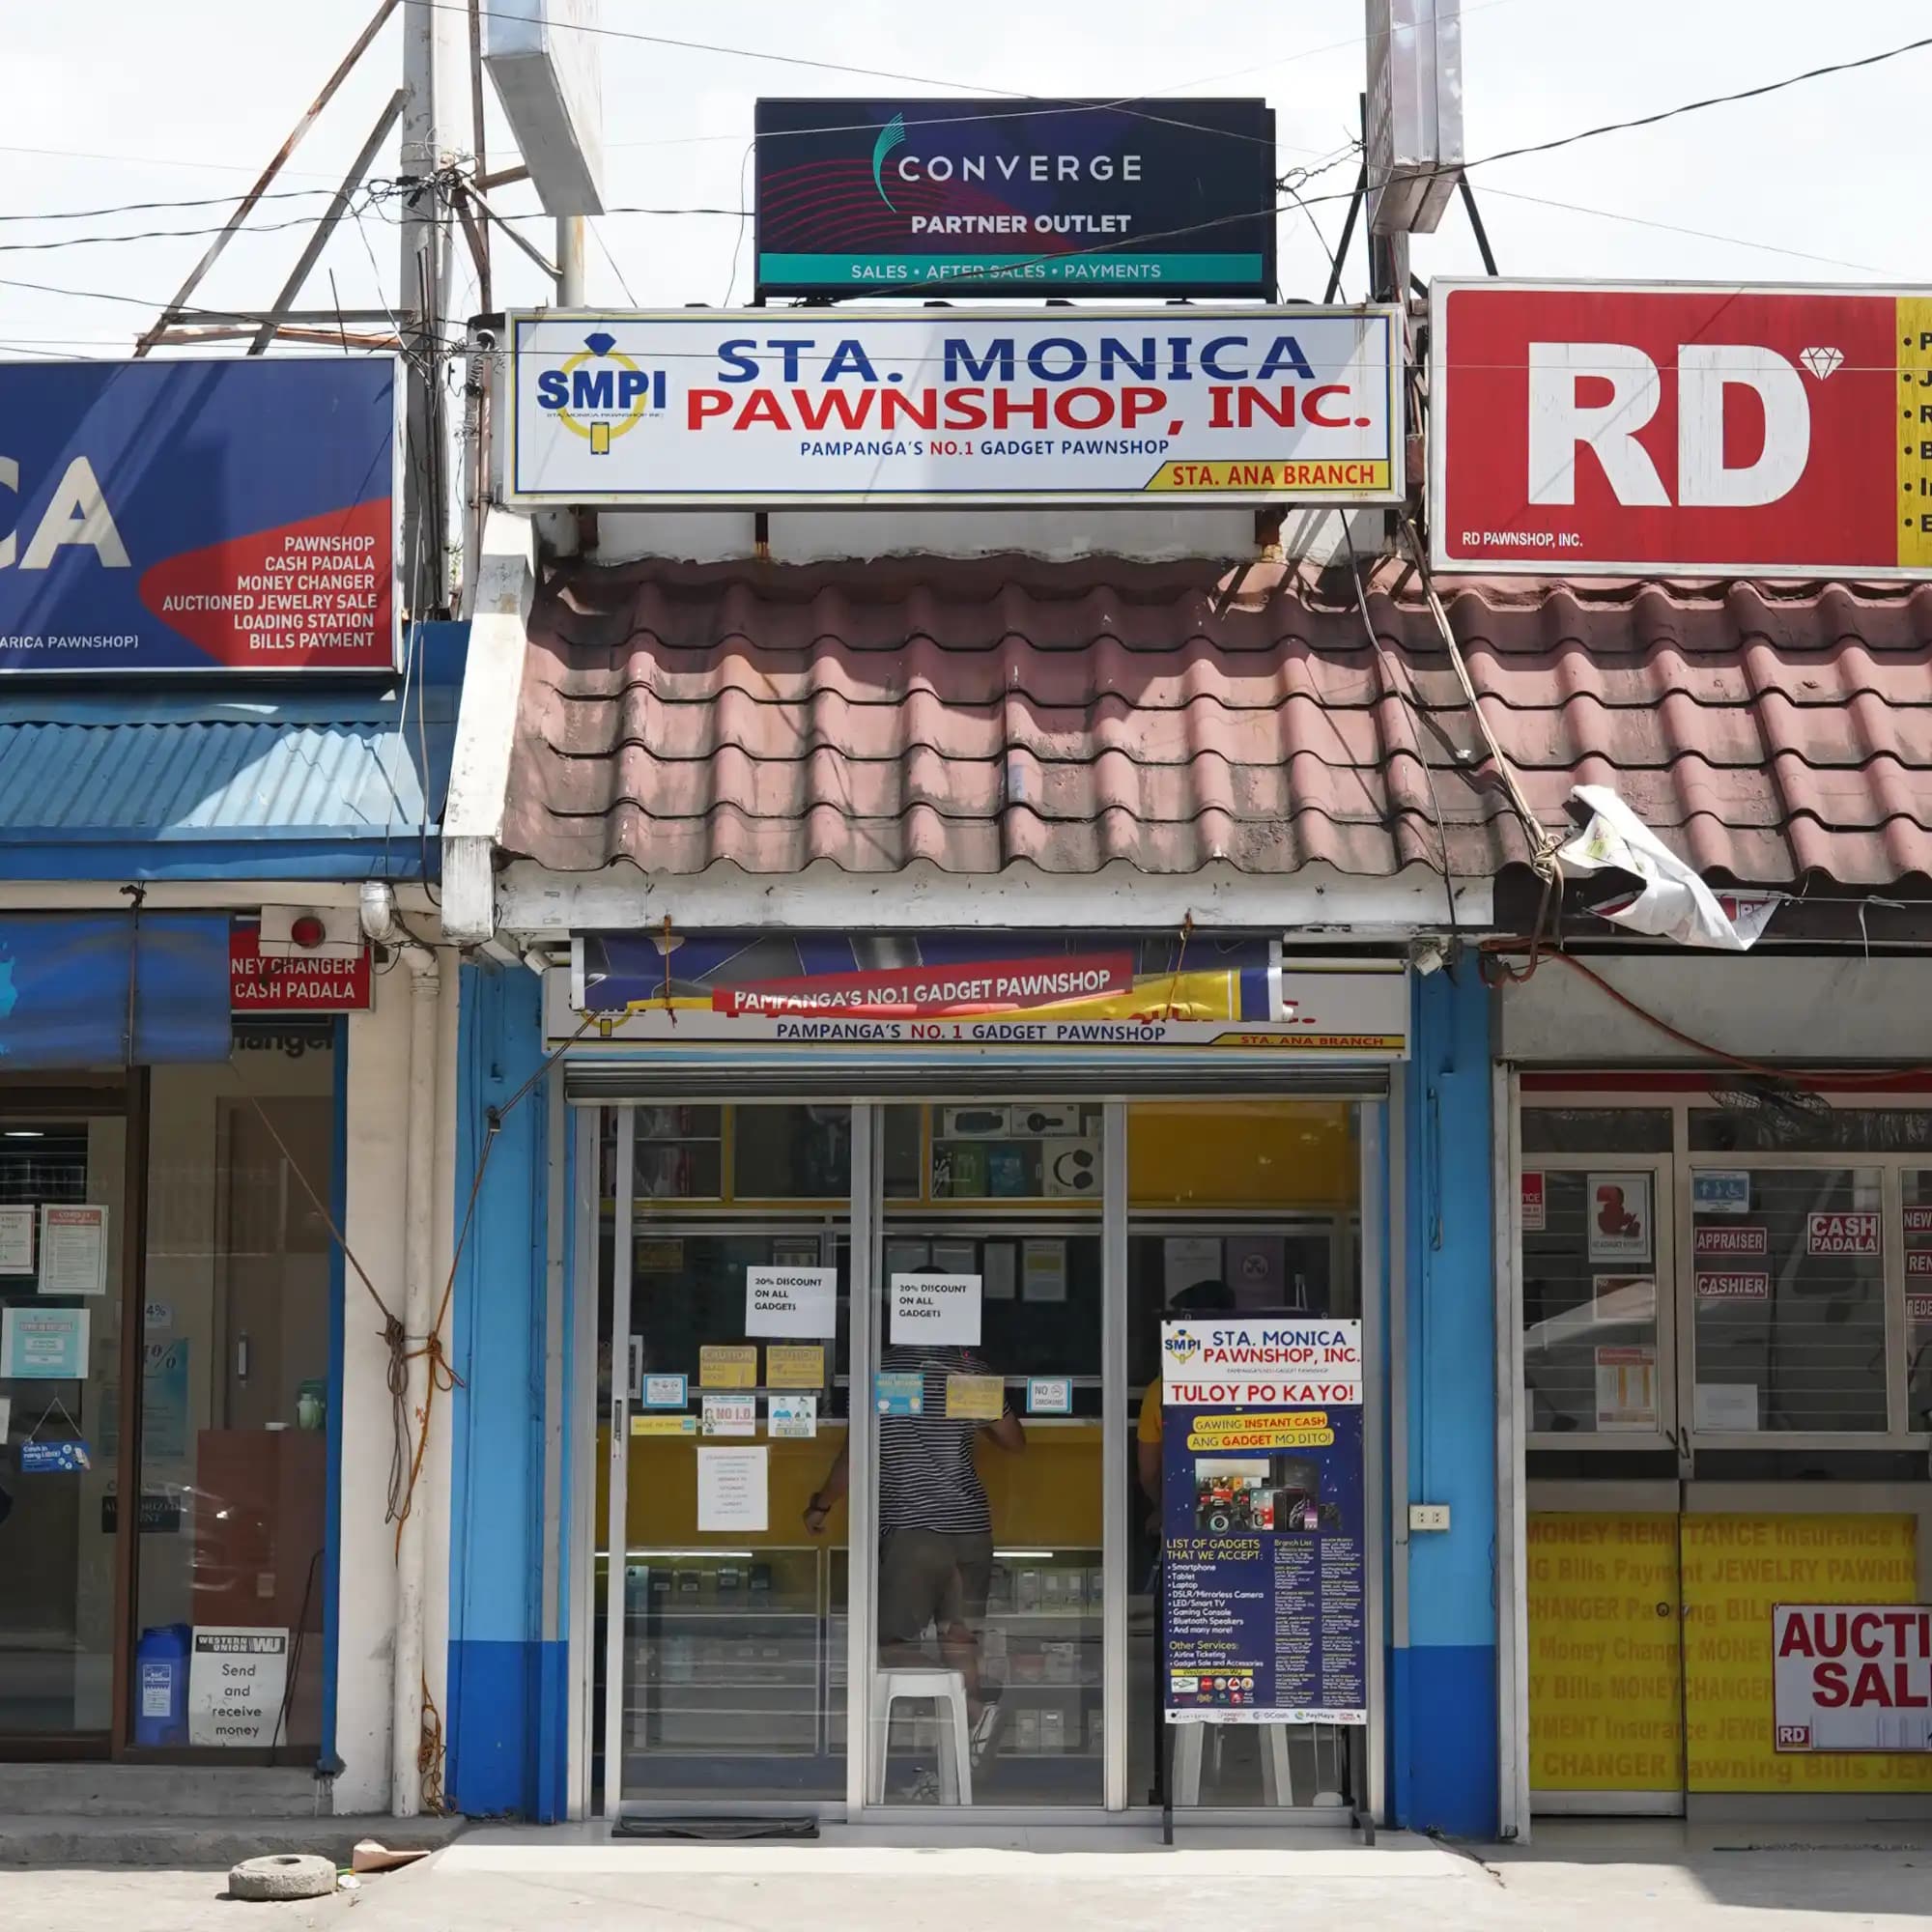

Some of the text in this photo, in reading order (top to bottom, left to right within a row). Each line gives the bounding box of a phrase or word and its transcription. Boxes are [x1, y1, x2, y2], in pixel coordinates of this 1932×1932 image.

[897, 154, 1143, 183] CONVERGE
[911, 213, 1132, 235] PARTNER OUTLET
[851, 263, 1162, 280] SALES AFTER SALES PAYMENTS
[717, 336, 1316, 384] STA. MONICA
[537, 369, 667, 411] SMPI
[687, 384, 1372, 436] PAWNSHOP, INC.
[1527, 341, 1812, 508] RD
[801, 440, 1170, 456] PAMPANGA'S NO.1 GADGET PAWNSHOP
[1172, 464, 1376, 487] STA. ANA BRANCH
[284, 536, 376, 553] PAWNSHOP
[1462, 531, 1584, 550] RD PAWNSHOP, INC.
[265, 554, 376, 572] CASH PADALA
[237, 574, 376, 591] MONEY CHANGER
[162, 593, 378, 611] AUCTIONED JEWELRY SALE
[233, 612, 375, 631] LOADING STATION
[47, 635, 139, 649] PAWNSHOP)
[248, 633, 376, 650] BILLS PAYMENT
[231, 957, 356, 976] NEY CHANGER
[235, 981, 356, 999] CASH PADALA
[867, 985, 909, 1005] NO.1
[913, 979, 992, 1003] GADGET
[996, 970, 1111, 998] PAWNSHOP
[777, 1023, 901, 1039] PAMPANGA'S
[972, 1024, 1046, 1041] GADGET
[1056, 1025, 1167, 1042] PAWNSHOP
[1240, 1036, 1384, 1046] STA. ANA BRANCH
[1810, 1216, 1878, 1237] CASH
[1696, 1233, 1764, 1250] APPRAISER
[1810, 1236, 1877, 1252] PADALA
[754, 1277, 823, 1288] 20% DISCOUNT
[899, 1284, 967, 1294] 20% DISCOUNT
[1697, 1277, 1766, 1295] CASHIER
[754, 1290, 789, 1299] ON ALL
[899, 1296, 934, 1306] ON ALL
[754, 1301, 797, 1312] GADGETS
[898, 1308, 942, 1319] GADGETS
[1164, 1339, 1202, 1350] SMPI
[1212, 1330, 1347, 1347] STA. MONICA
[1204, 1348, 1361, 1365] PAWNSHOP, INC.
[1035, 1385, 1048, 1396] NO
[1172, 1384, 1354, 1402] TULOY PO KAYO!
[1195, 1416, 1326, 1431] GAWING INSTANT CASH
[1192, 1433, 1331, 1447] ANG GADGET MO DITO!
[1776, 1523, 1889, 1547] Insurance
[1166, 1539, 1261, 1549] LIST OF GADGETS
[1167, 1549, 1264, 1561] THAT WE ACCEPT:
[1172, 1563, 1217, 1572] Smartphone
[1558, 1558, 1606, 1581] Bills
[1711, 1559, 1819, 1583] JEWELRY
[1172, 1581, 1199, 1590] Laptop
[1173, 1608, 1201, 1617] Gaming
[1173, 1617, 1244, 1627] Bluetooth Speakers
[1173, 1626, 1189, 1634] And
[1189, 1627, 1213, 1635] many
[1778, 1611, 1931, 1659] AUCTI
[198, 1635, 248, 1645] WESTERN
[213, 1643, 248, 1652] UNION
[1169, 1641, 1195, 1650] Other
[1195, 1651, 1227, 1660] Ticketing
[1540, 1637, 1605, 1665] Money
[221, 1663, 257, 1677] Send
[1173, 1660, 1197, 1668] Gadget
[224, 1686, 250, 1697] and
[1811, 1662, 1932, 1709] SAL
[212, 1706, 263, 1718] receive
[215, 1725, 260, 1738] money
[1779, 1727, 1805, 1743] RD
[1543, 1752, 1667, 1777] CHANGER
[1804, 1753, 1868, 1779] Bills
